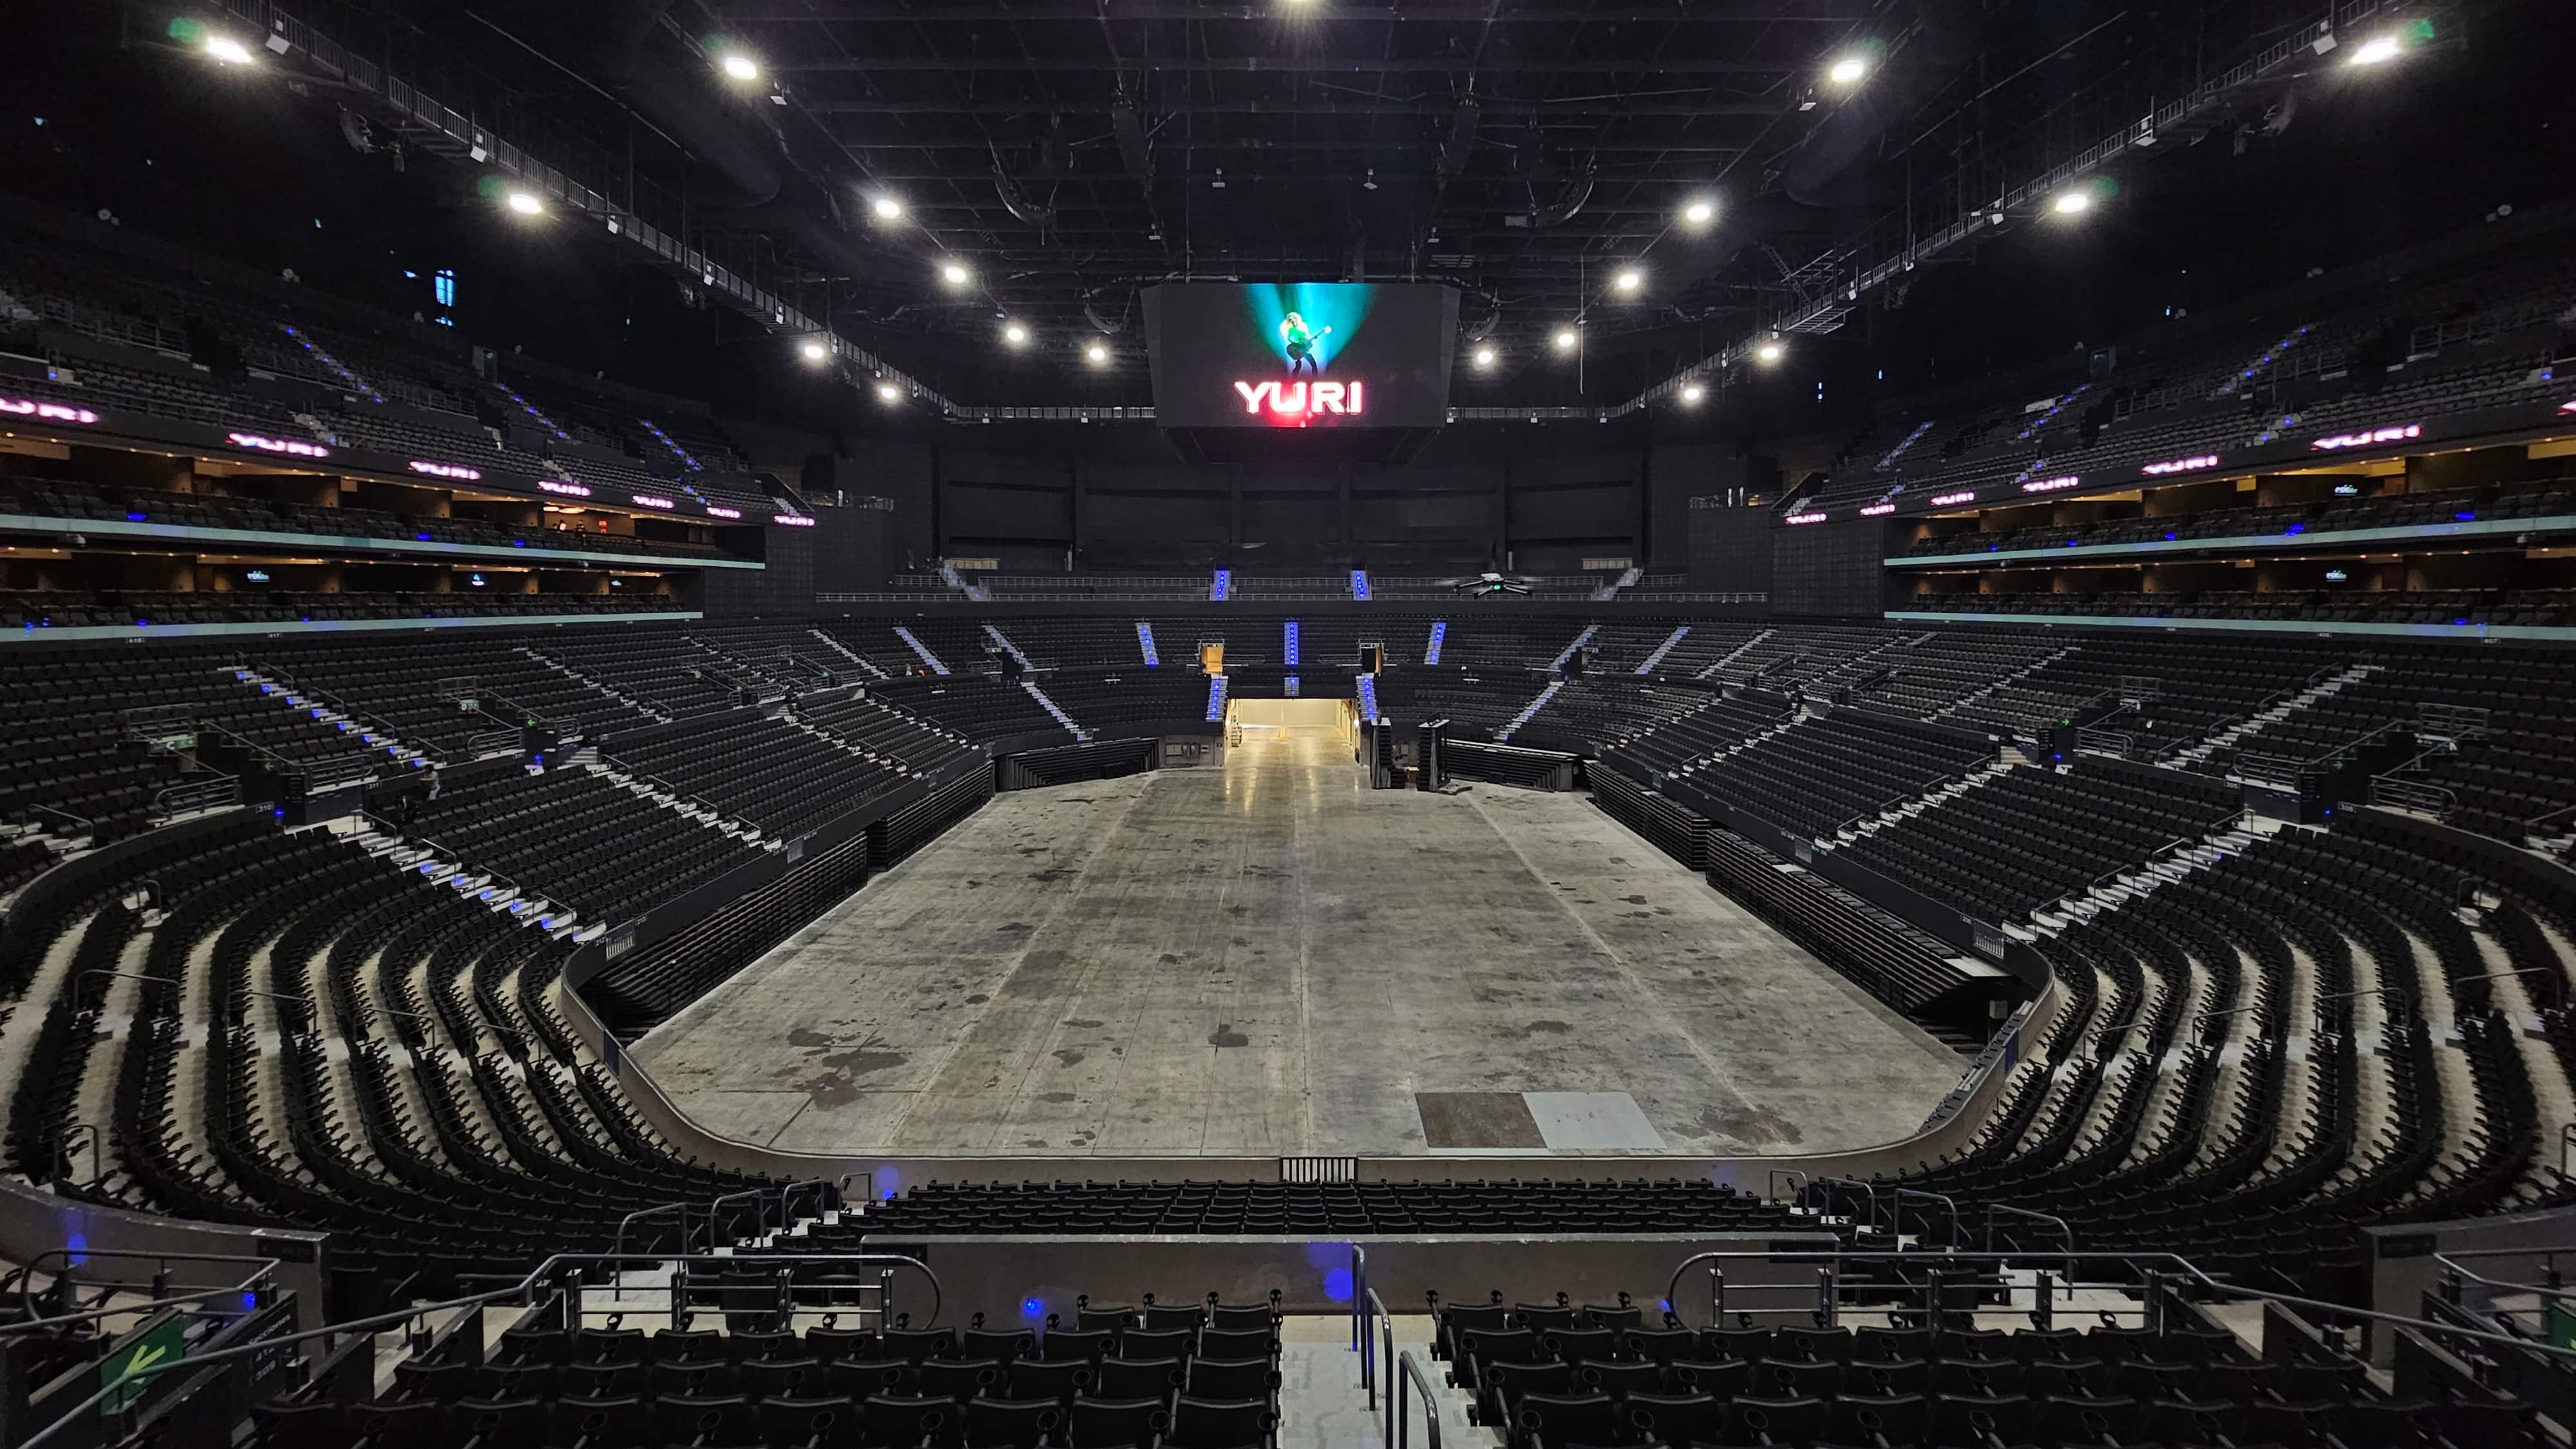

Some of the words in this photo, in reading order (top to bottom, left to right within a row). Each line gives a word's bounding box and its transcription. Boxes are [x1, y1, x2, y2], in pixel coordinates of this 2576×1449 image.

[0, 398, 98, 423] URI
[1235, 382, 1362, 415] YURI
[227, 433, 329, 457] YURI
[2311, 425, 2420, 450] YURI
